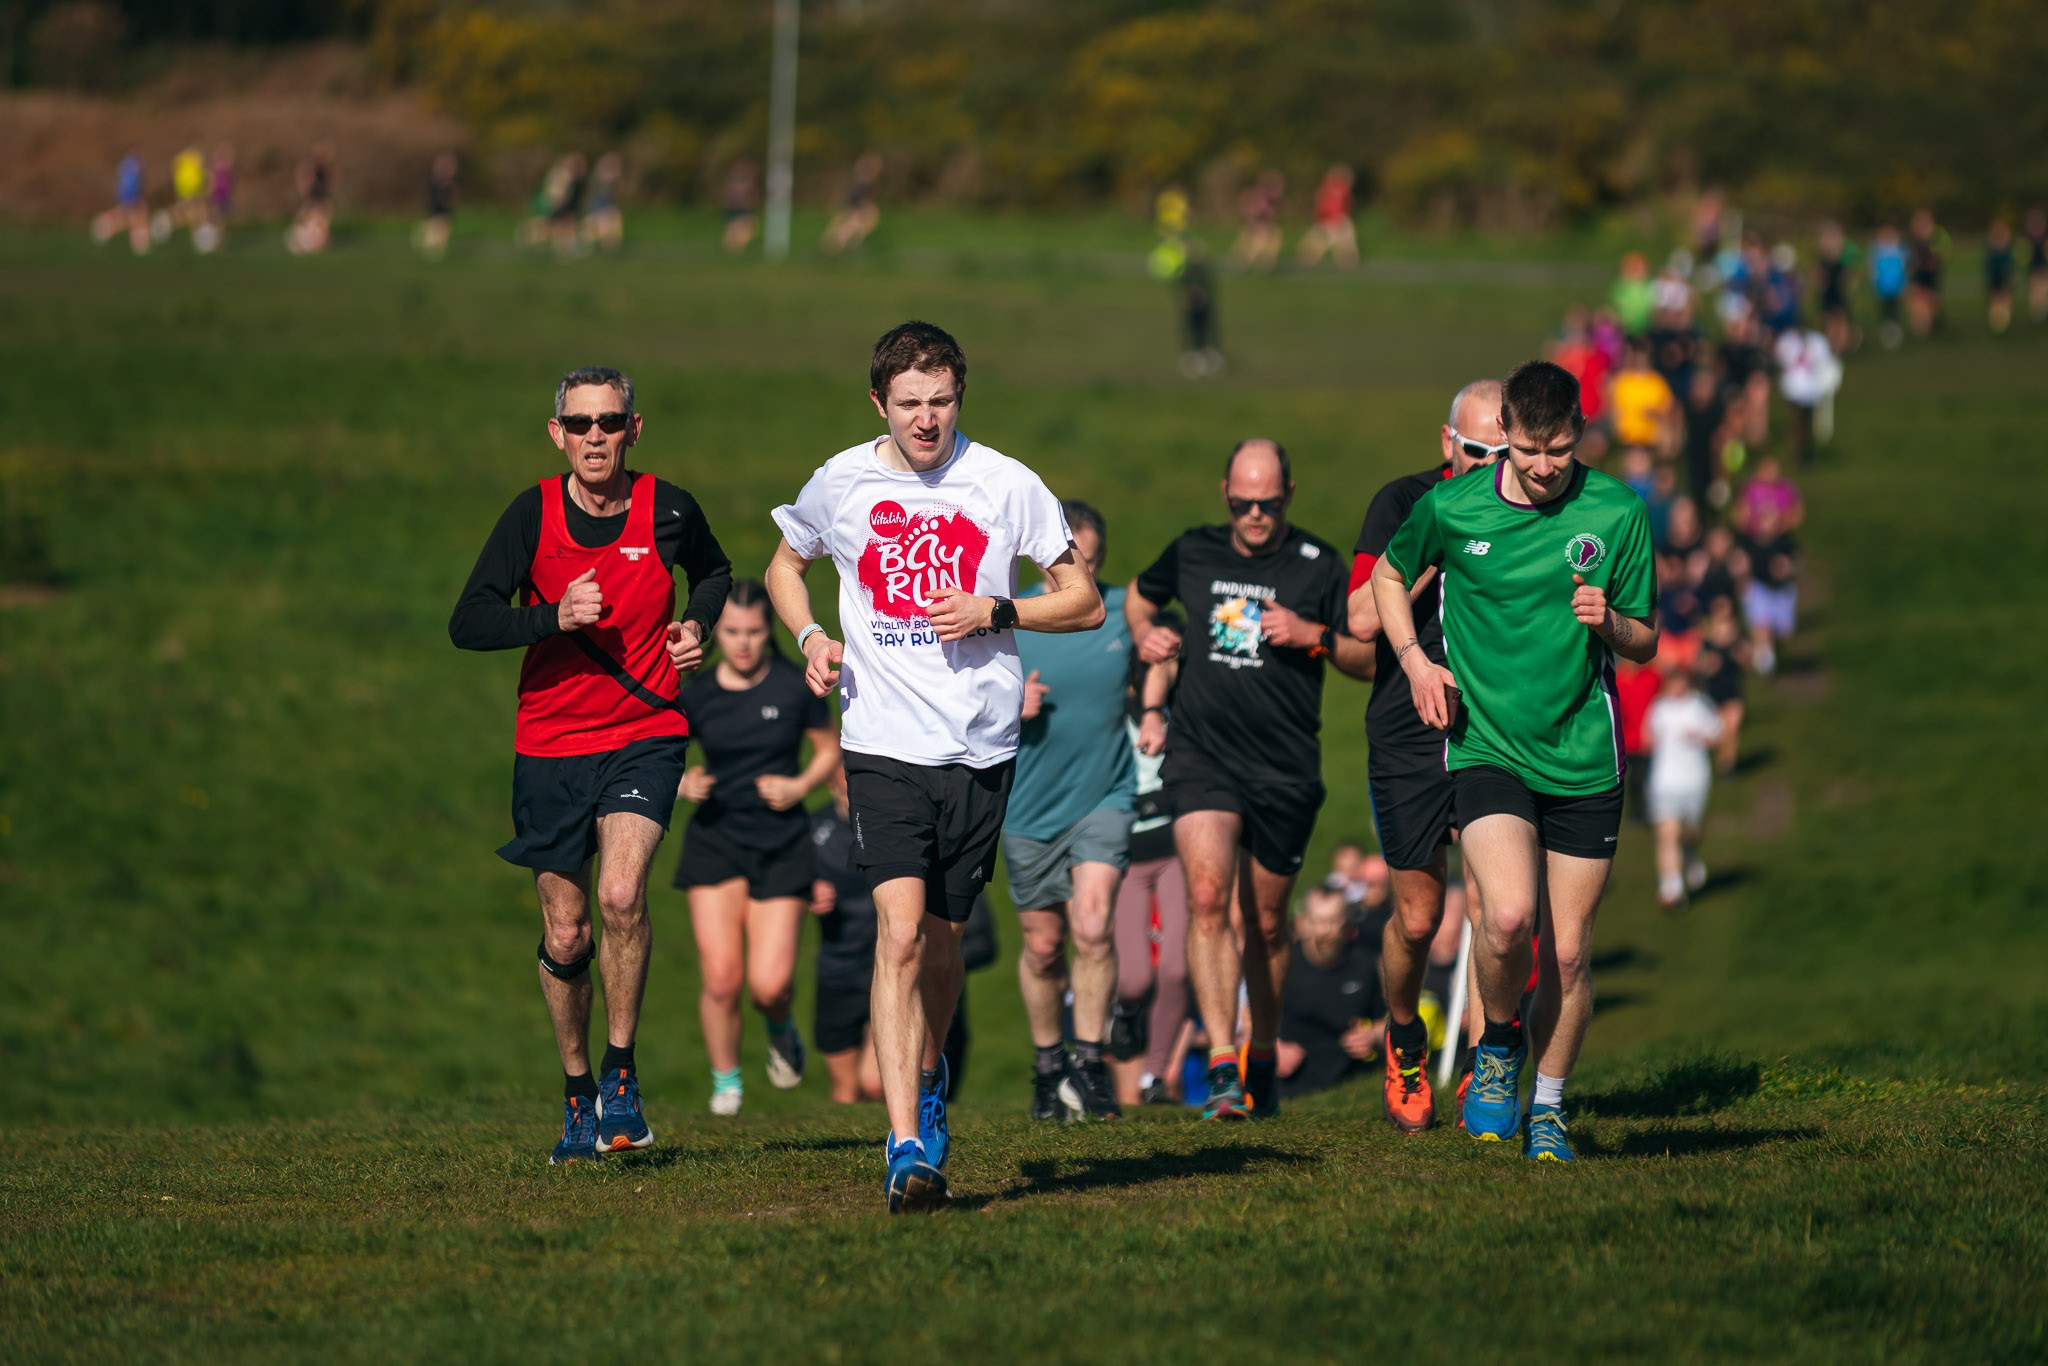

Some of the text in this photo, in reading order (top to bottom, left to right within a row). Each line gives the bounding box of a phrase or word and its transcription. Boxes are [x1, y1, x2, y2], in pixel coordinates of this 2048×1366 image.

[870, 511, 907, 527] Vitality
[870, 620, 911, 630] VITALITY
[873, 632, 905, 647] BAY
